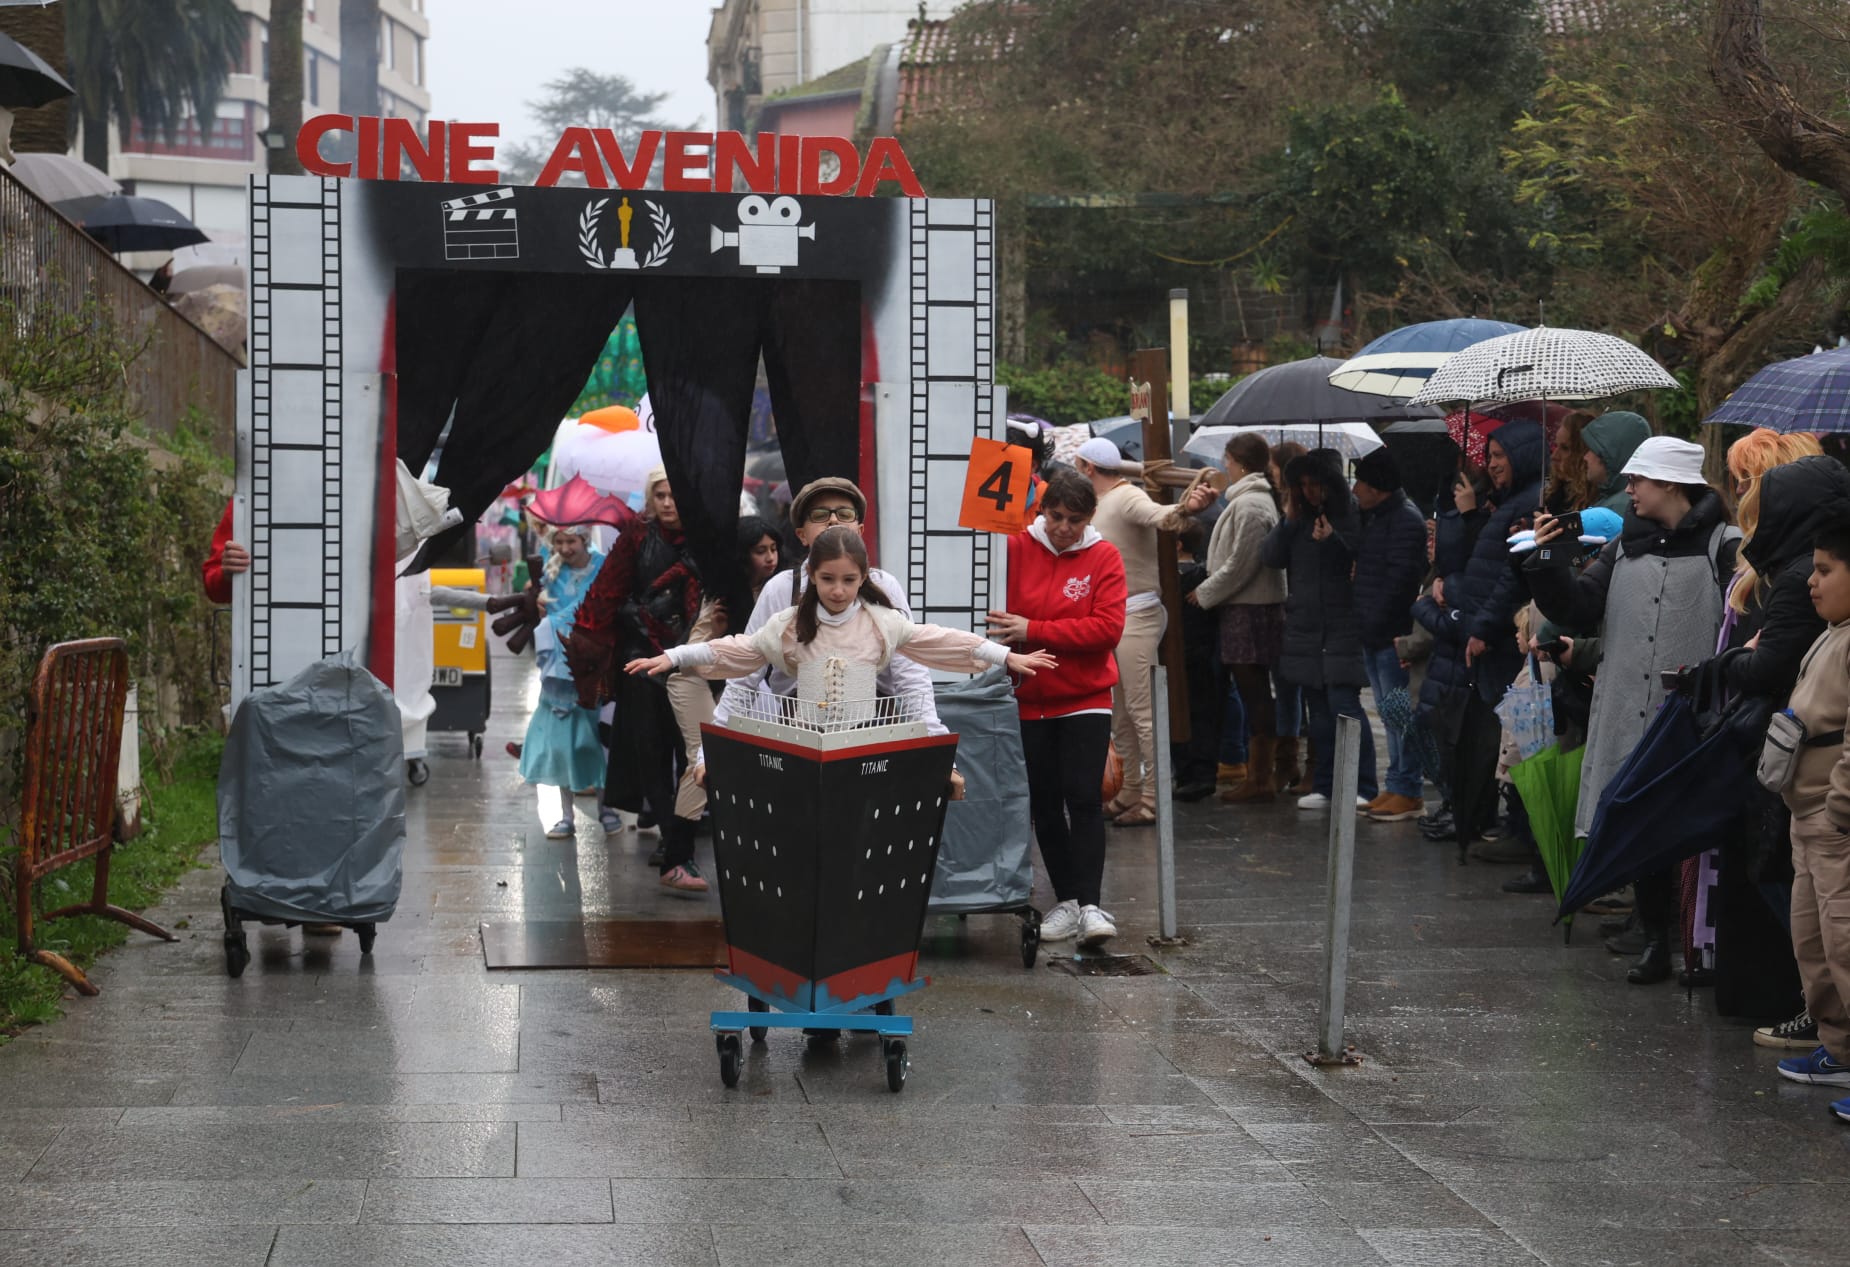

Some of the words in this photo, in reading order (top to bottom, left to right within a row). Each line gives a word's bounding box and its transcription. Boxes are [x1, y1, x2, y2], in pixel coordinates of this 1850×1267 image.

[296, 113, 500, 184] CINE
[535, 127, 926, 198] AVENIDA
[977, 460, 1014, 512] 4
[758, 753, 784, 771] TITANIC
[860, 759, 889, 776] TITANIC
